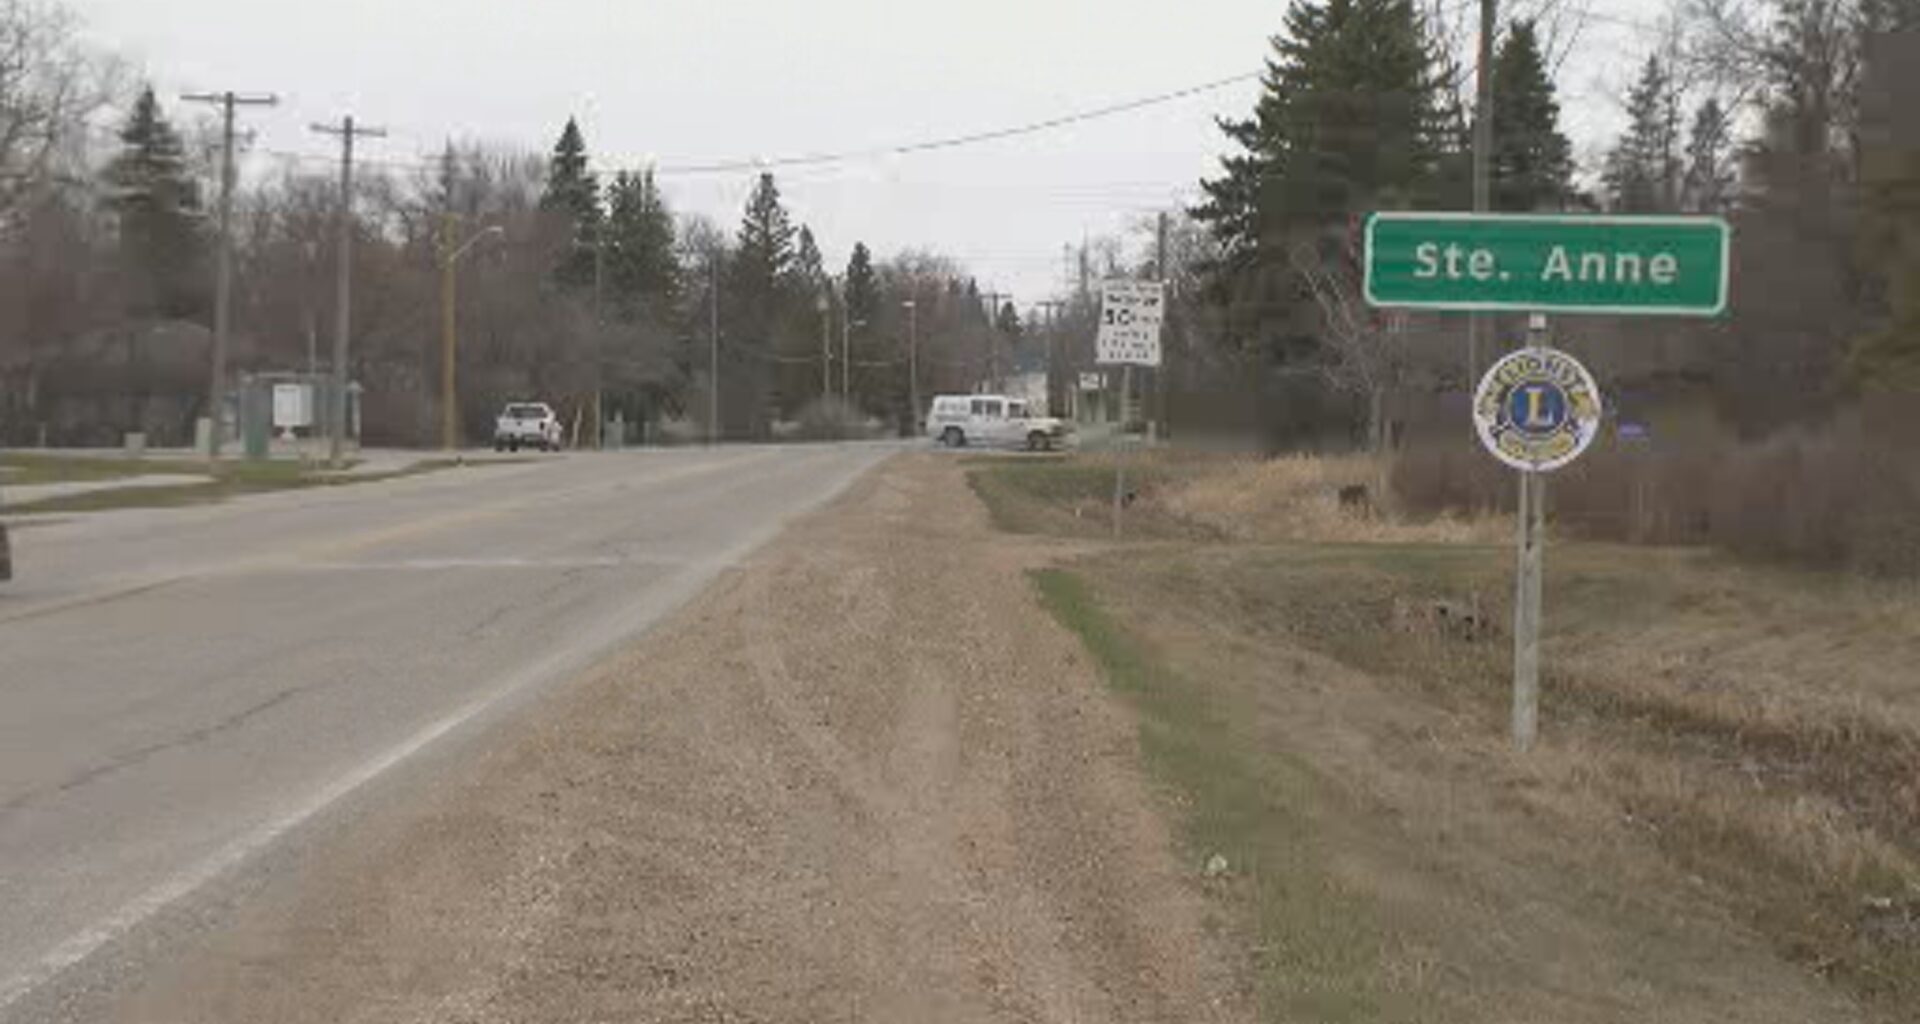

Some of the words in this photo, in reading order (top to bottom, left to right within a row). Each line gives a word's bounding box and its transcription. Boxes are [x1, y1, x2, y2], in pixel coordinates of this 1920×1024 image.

[1413, 241, 1511, 282] Ste.
[1540, 245, 1679, 284] Anne
[1525, 387, 1554, 427] L
